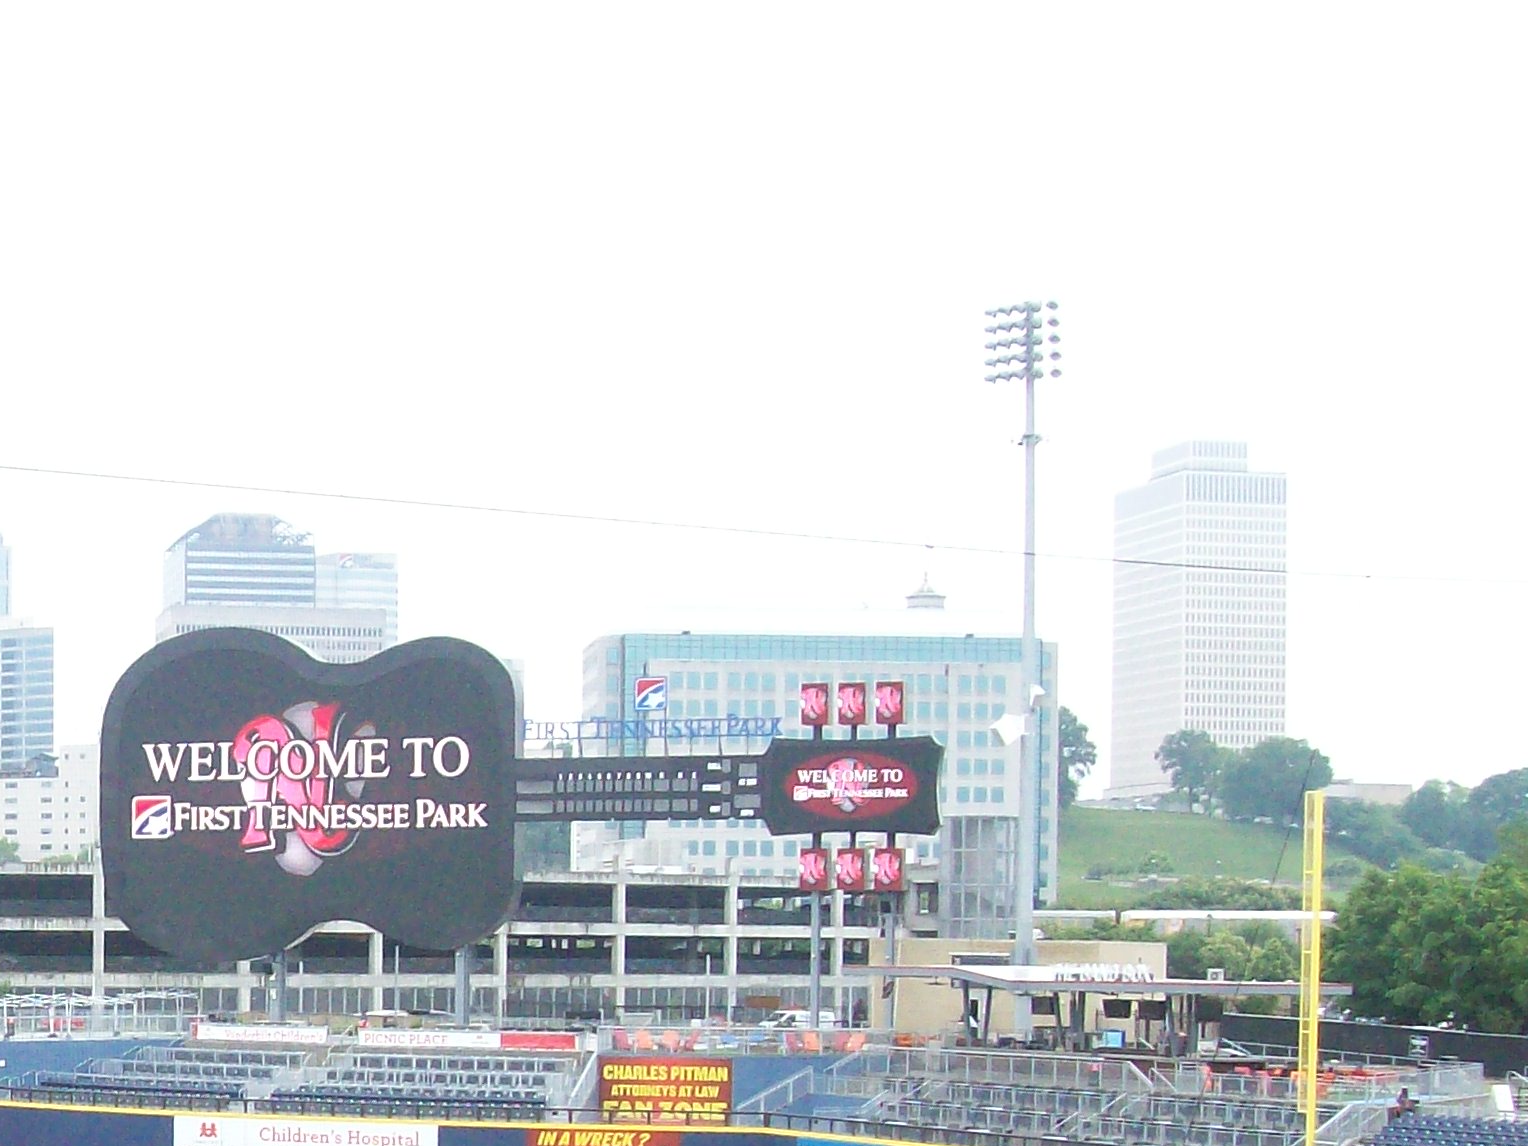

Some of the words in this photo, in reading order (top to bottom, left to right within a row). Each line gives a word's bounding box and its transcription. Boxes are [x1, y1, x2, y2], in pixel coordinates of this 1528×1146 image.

[522, 719, 583, 740] FIRST
[726, 713, 784, 736] PARK
[142, 739, 391, 782] WELCOME
[403, 736, 471, 778] TO
[797, 769, 878, 783] WELCOME
[881, 768, 903, 783] TO
[173, 802, 248, 831] FIRST
[248, 800, 410, 830] TENNESSEE
[415, 798, 488, 828] PARK
[363, 1033, 407, 1044] PICNIC
[409, 1034, 448, 1045] PLACE
[603, 1064, 668, 1080] CHARLES
[670, 1065, 728, 1081] PITMAN
[611, 1084, 677, 1097] ATTORNEYS
[678, 1085, 693, 1098] AT
[695, 1085, 720, 1098] LAW
[602, 1100, 653, 1119] FAN
[658, 1101, 728, 1120] ZONE
[259, 1126, 342, 1144] Children's
[537, 1130, 557, 1146] IN
[558, 1131, 571, 1146] A
